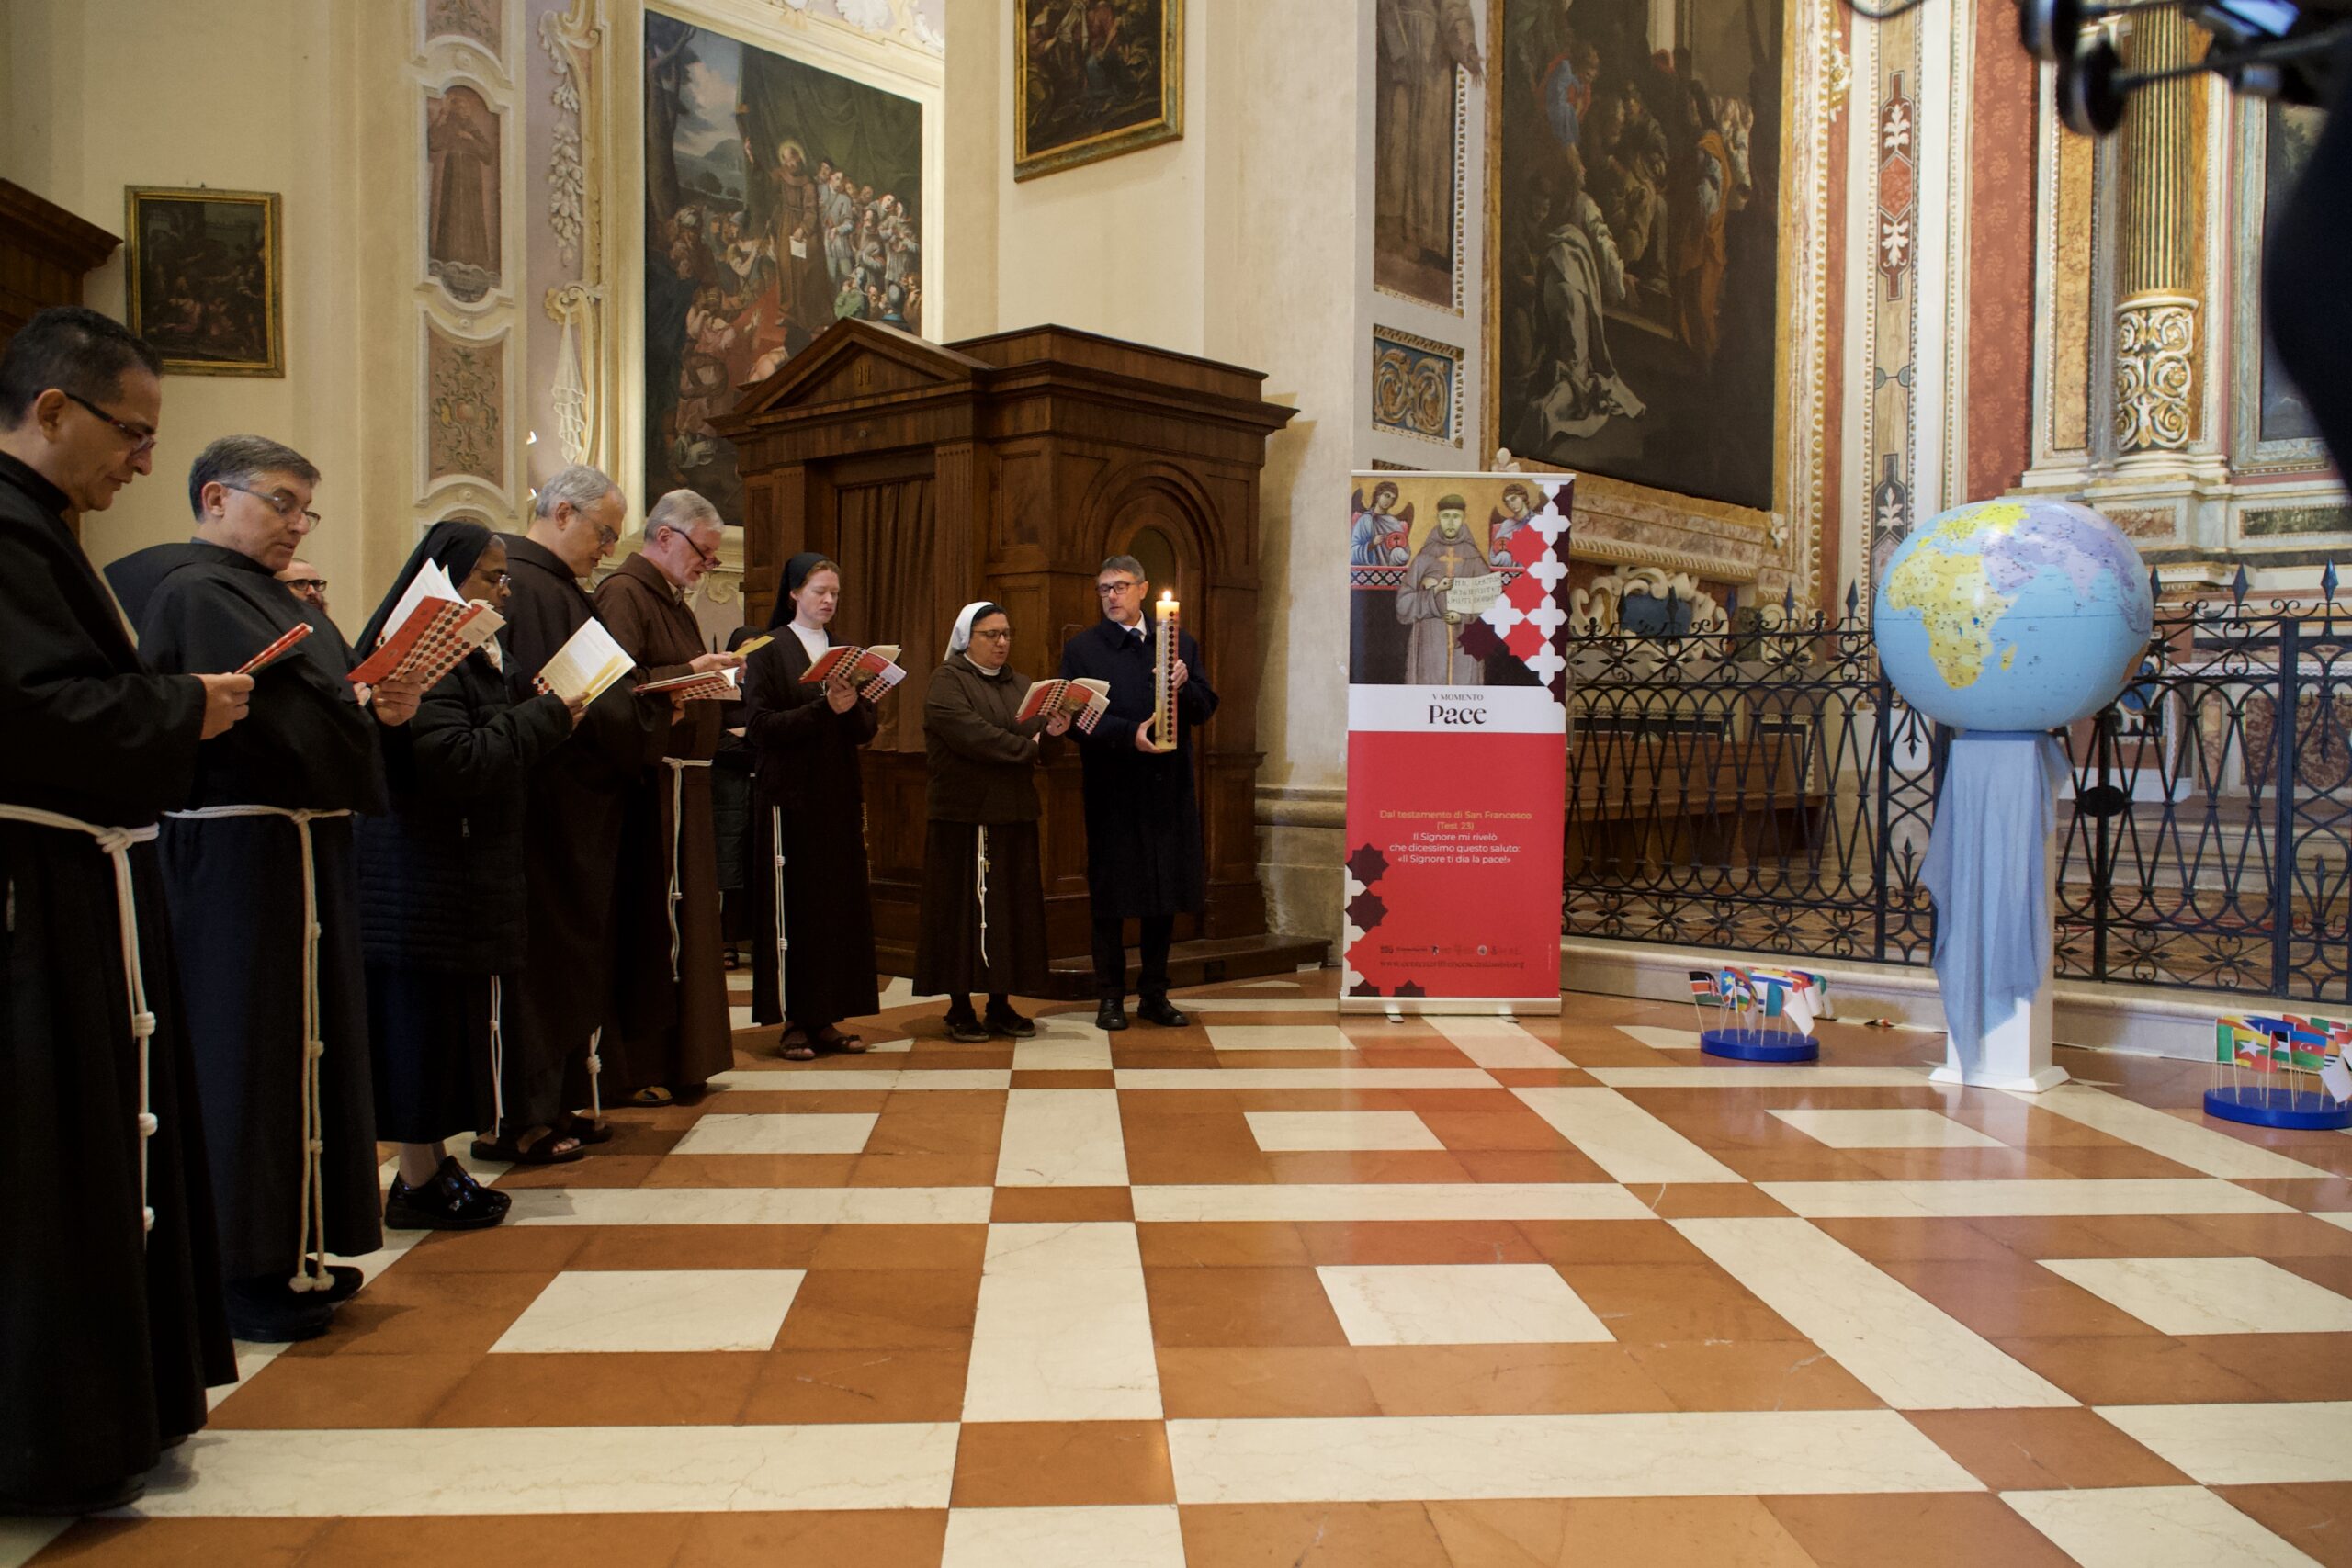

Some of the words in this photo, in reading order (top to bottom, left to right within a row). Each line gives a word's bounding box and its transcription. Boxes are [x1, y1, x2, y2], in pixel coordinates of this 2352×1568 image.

[1429, 705, 1487, 725] Pace
[1380, 810, 1396, 818] Dal
[1465, 811, 1483, 819] San
[1485, 811, 1532, 819] Francesco
[1420, 833, 1456, 841] Signore
[1473, 833, 1498, 841] rivelò
[1408, 843, 1455, 852] dicessimo
[1410, 855, 1445, 864] Signore
